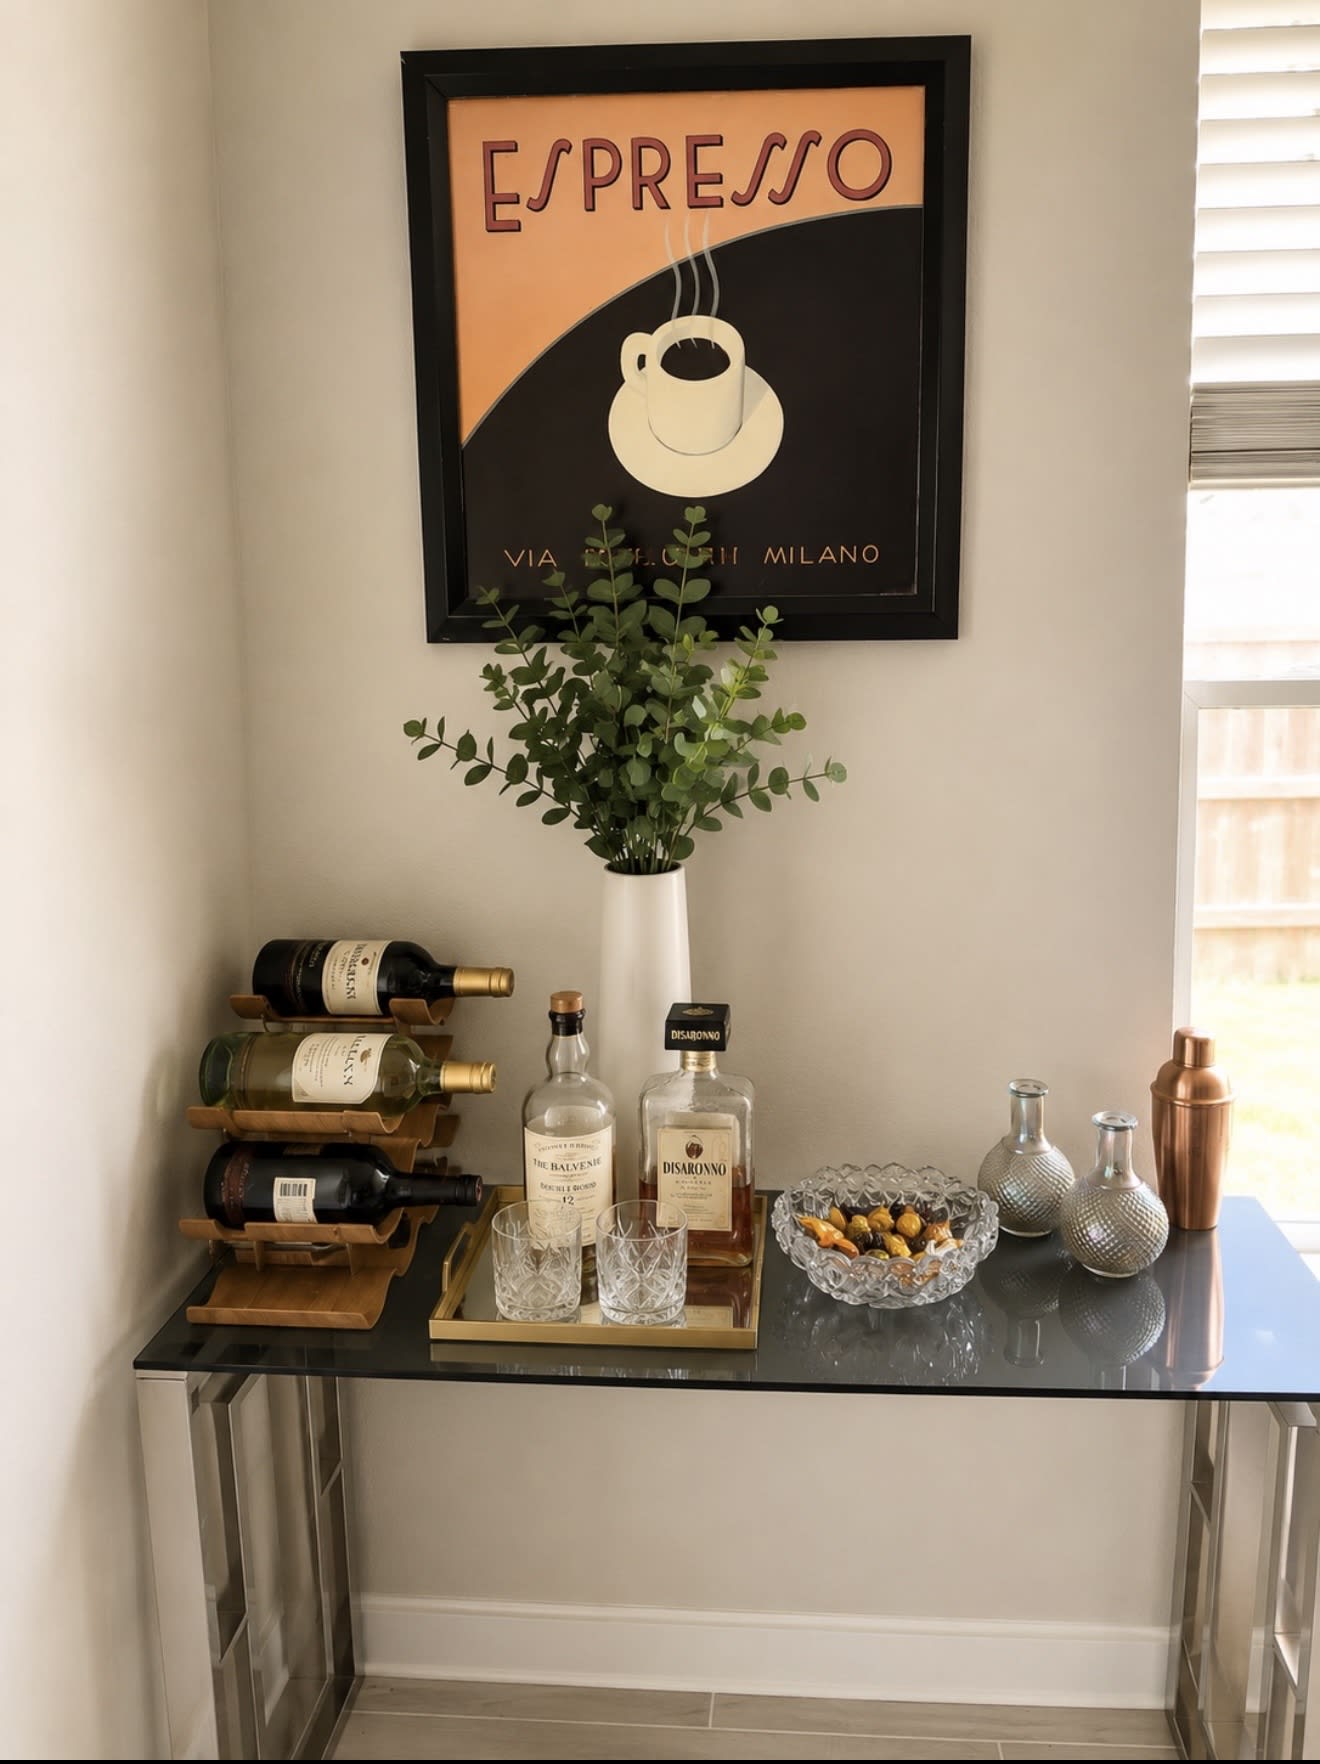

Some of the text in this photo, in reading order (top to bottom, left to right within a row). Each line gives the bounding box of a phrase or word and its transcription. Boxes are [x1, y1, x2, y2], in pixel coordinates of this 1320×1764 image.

[482, 128, 892, 232] ESPRESSO
[504, 544, 880, 567] VIA MILANO
[671, 1029, 721, 1041] DISARONNO
[663, 1161, 727, 1177] DISARONNO
[562, 1195, 575, 1205] 12
